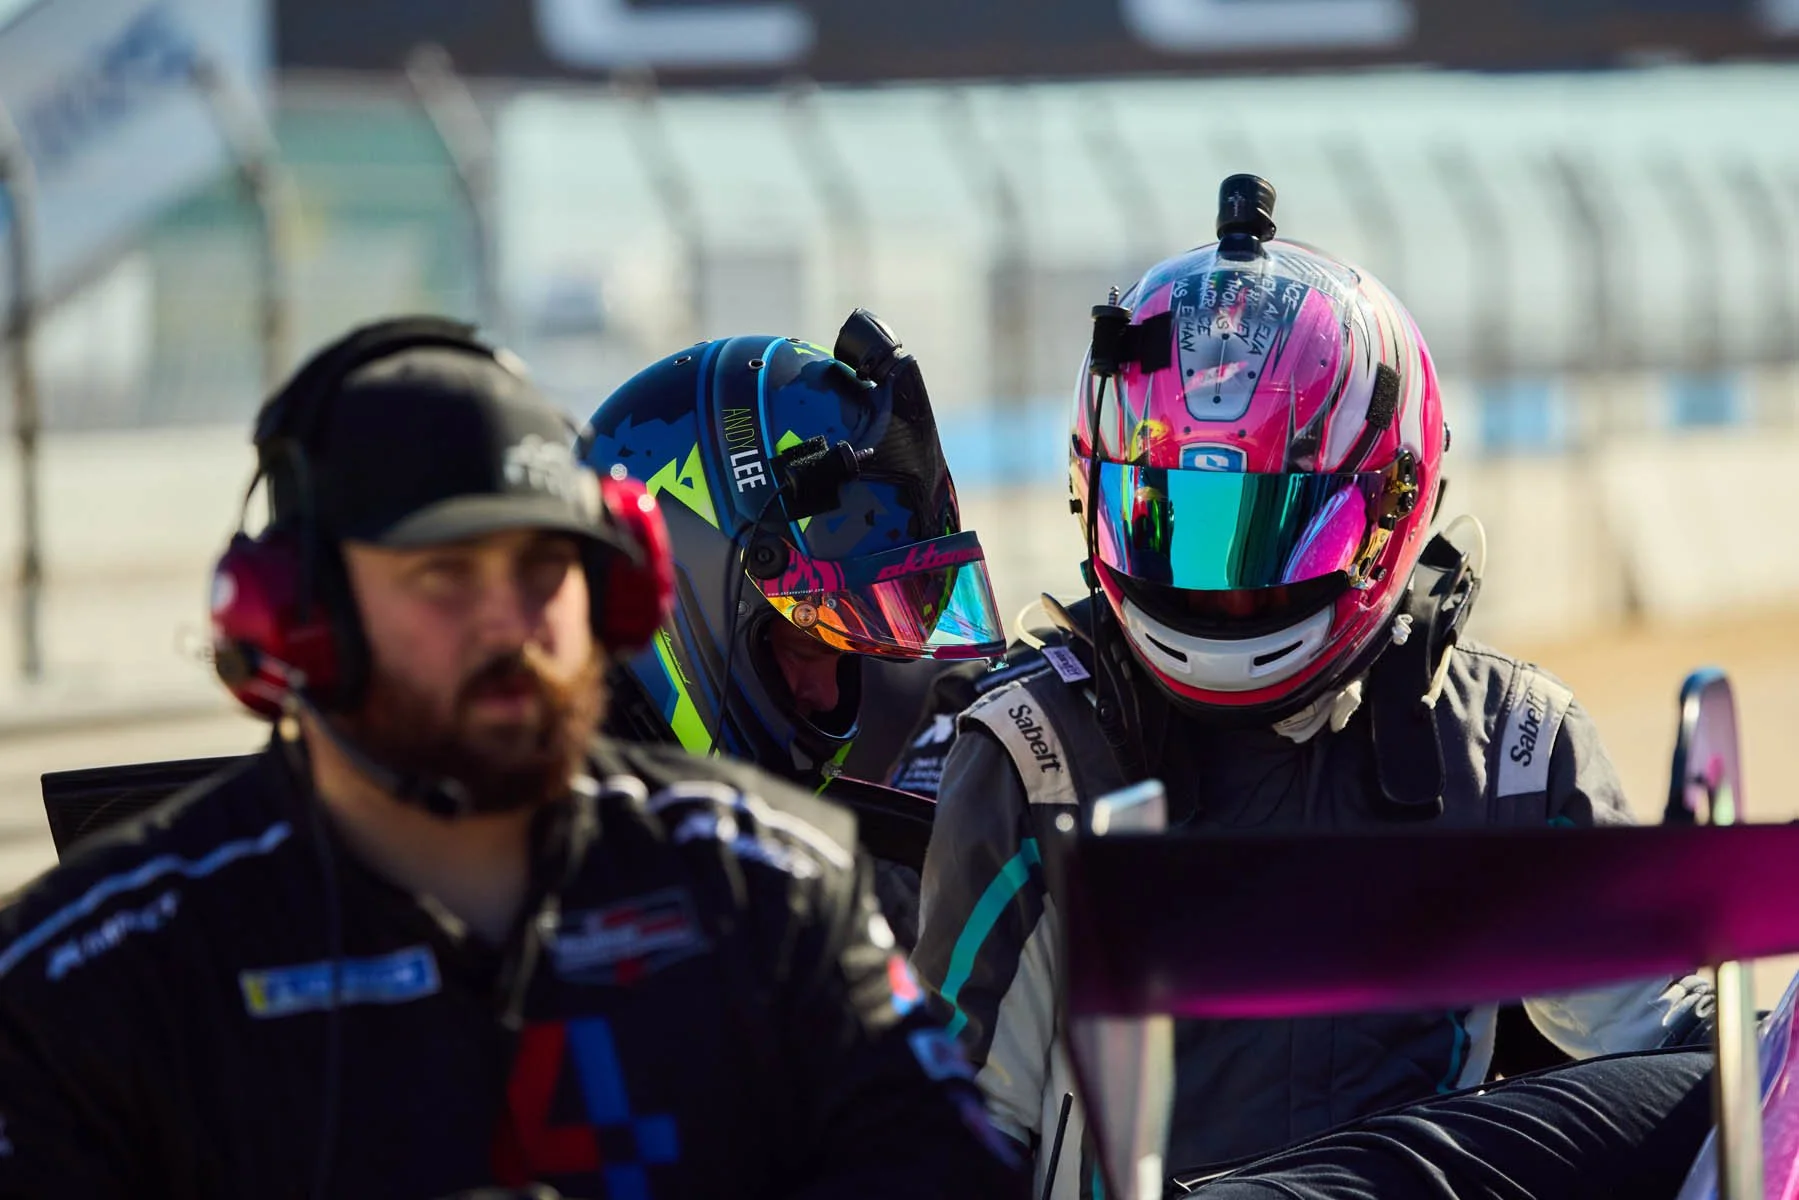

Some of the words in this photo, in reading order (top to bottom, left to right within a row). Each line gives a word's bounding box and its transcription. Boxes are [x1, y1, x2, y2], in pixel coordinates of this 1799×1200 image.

[1179, 304, 1196, 353] EHAN
[721, 408, 757, 451] ANDY
[730, 449, 767, 493] LEE
[1008, 704, 1062, 773] Sabelt
[1510, 690, 1546, 767] Sabelt
